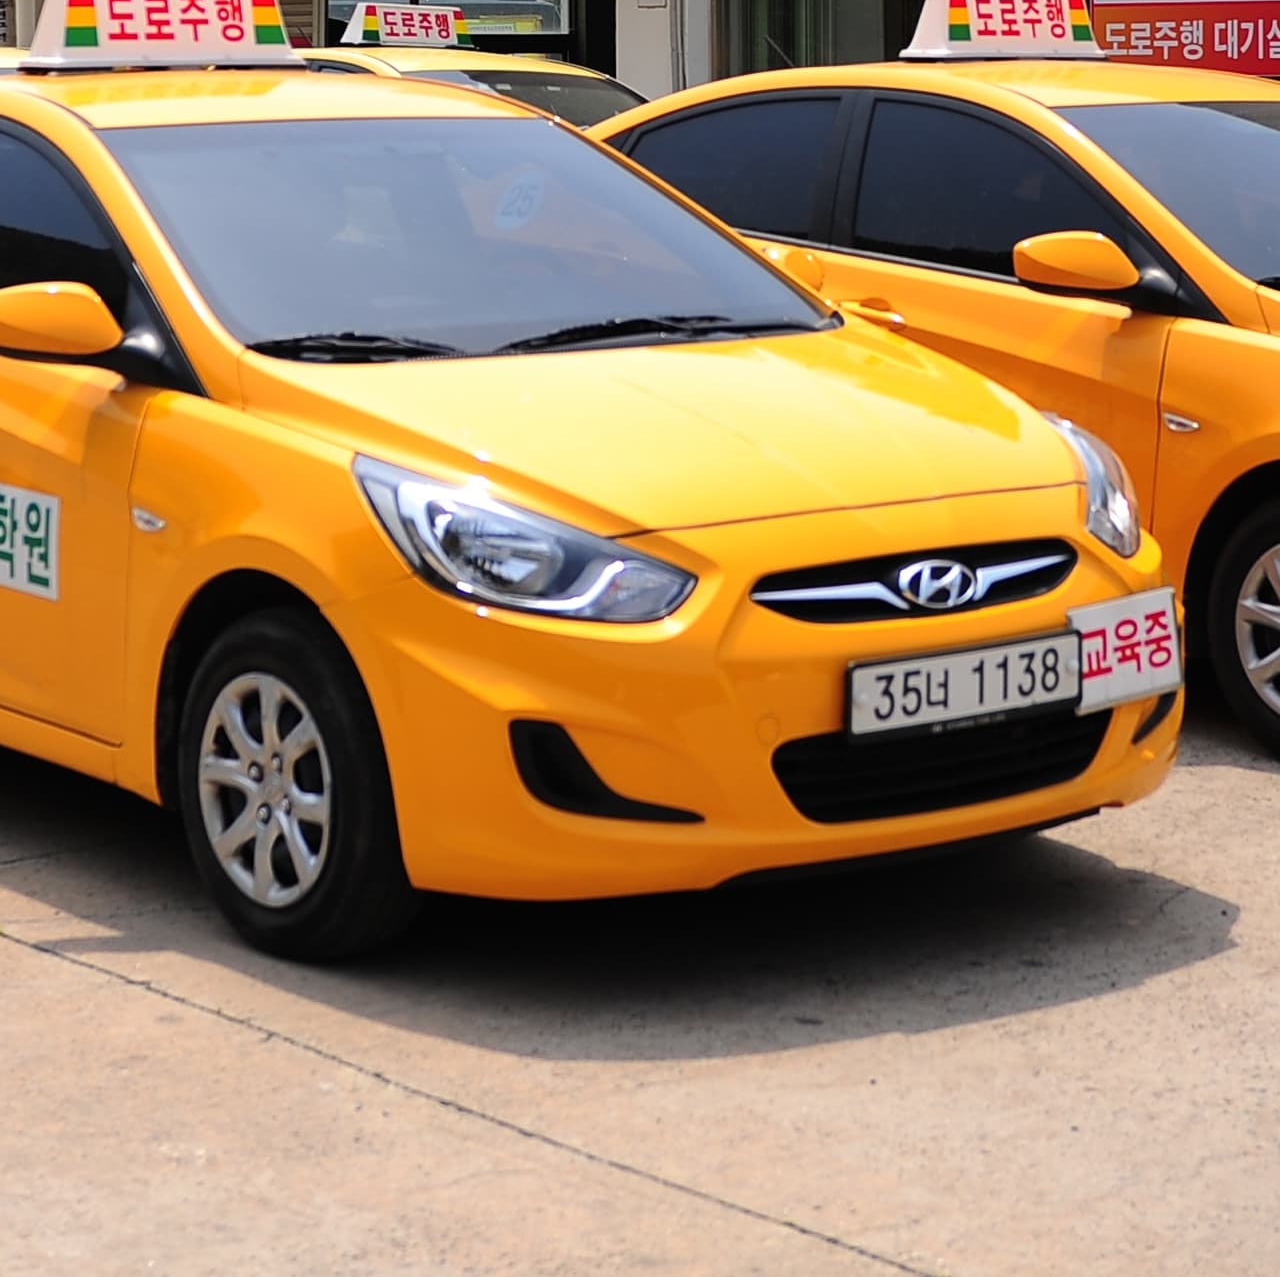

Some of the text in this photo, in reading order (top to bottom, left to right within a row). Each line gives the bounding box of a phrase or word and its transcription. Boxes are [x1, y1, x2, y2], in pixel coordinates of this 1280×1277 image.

[382, 10, 451, 40] 도로주행
[1104, 19, 1205, 61] 도로주행
[1081, 609, 1174, 681] 교육중
[873, 647, 1061, 722] 35너 1138
